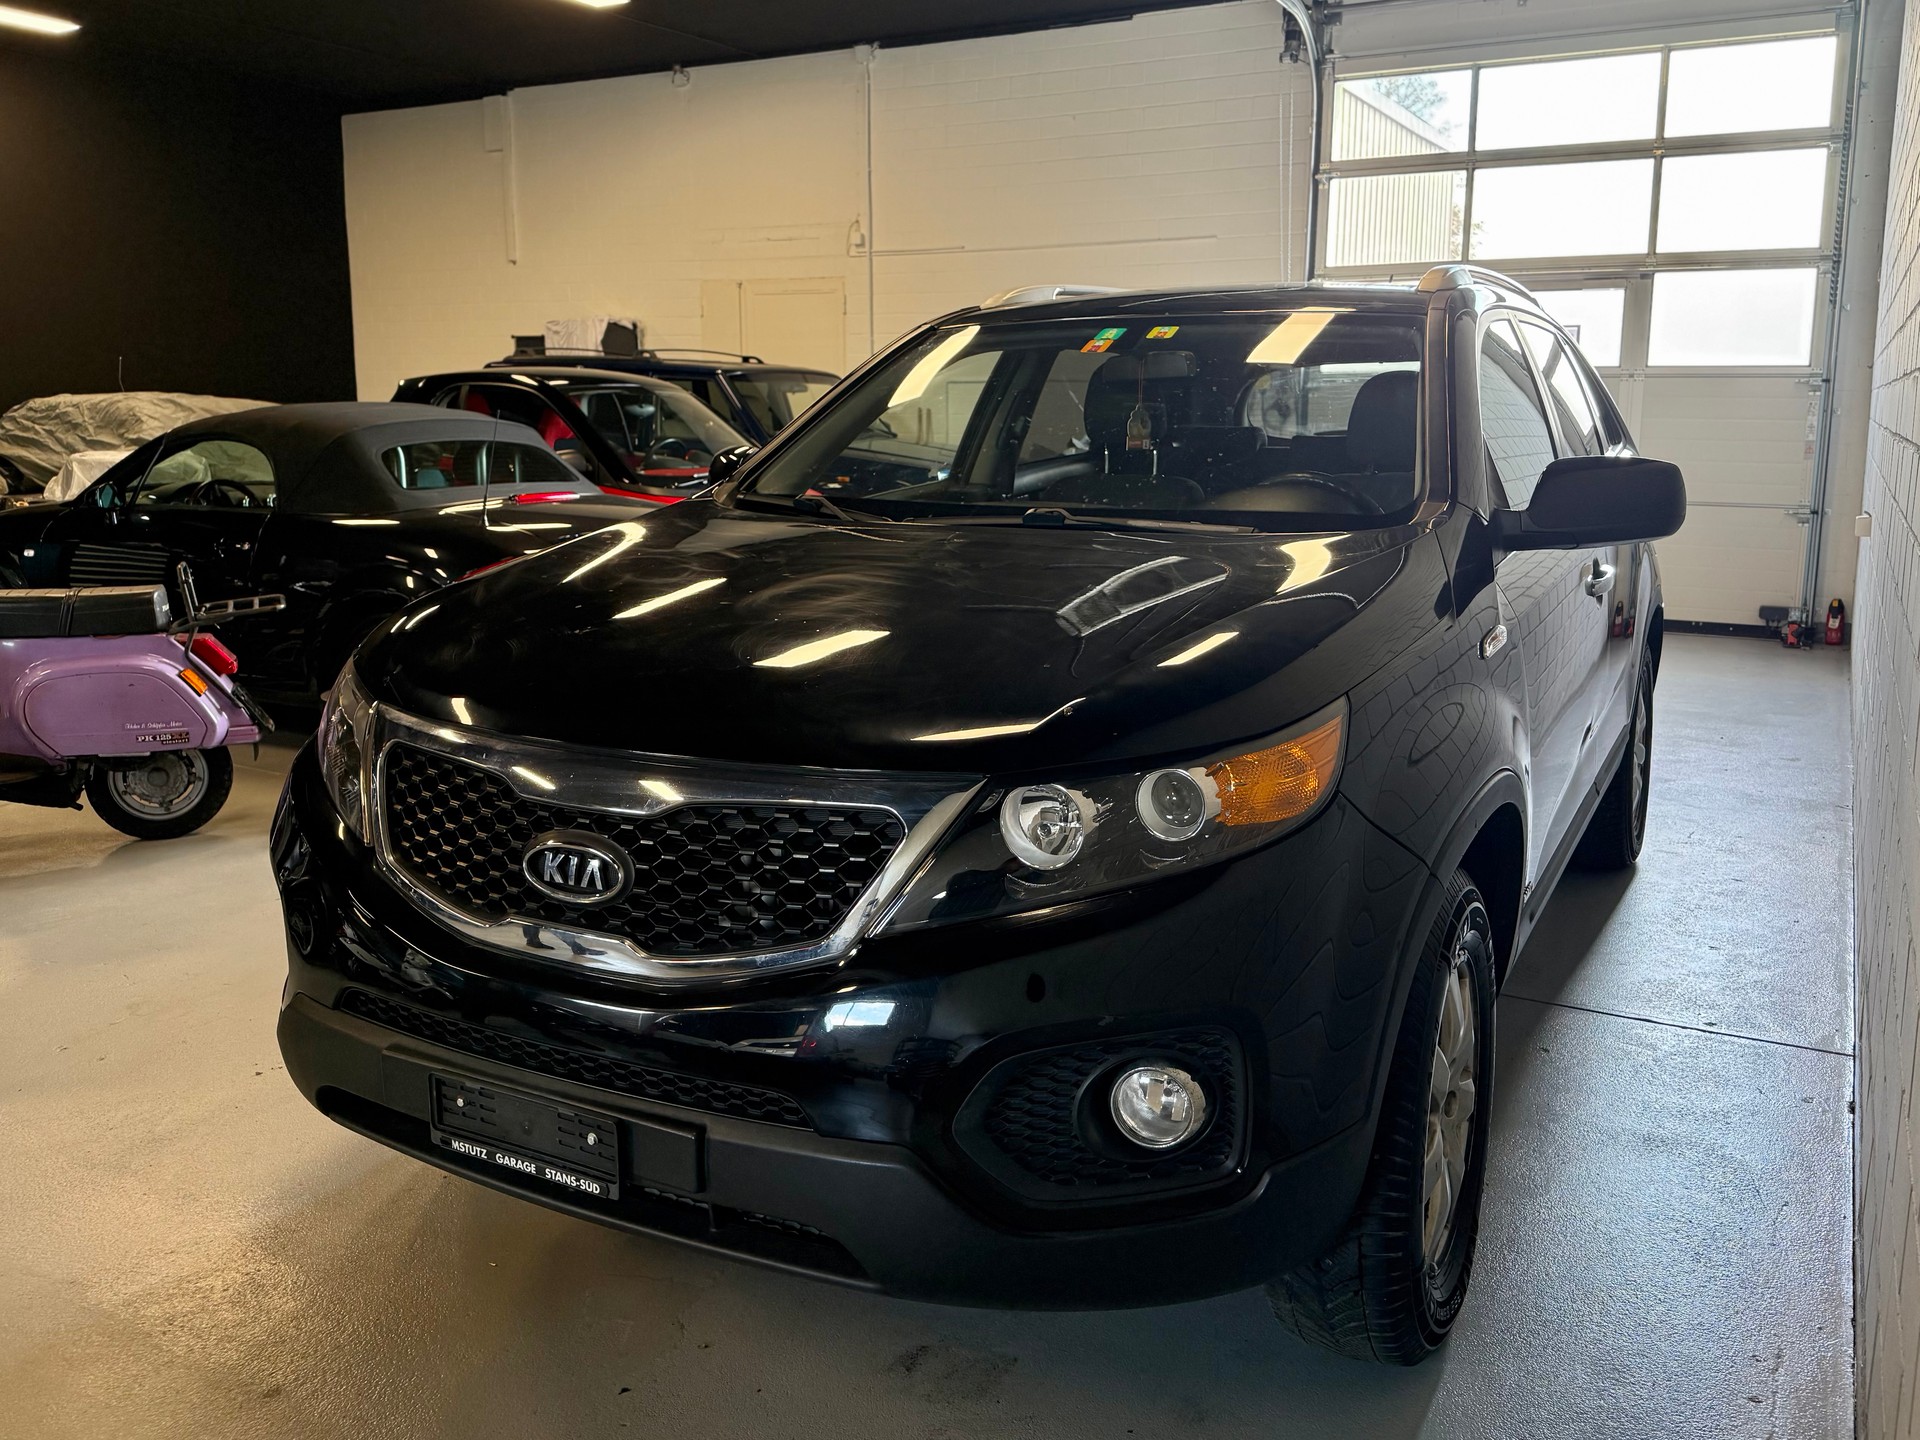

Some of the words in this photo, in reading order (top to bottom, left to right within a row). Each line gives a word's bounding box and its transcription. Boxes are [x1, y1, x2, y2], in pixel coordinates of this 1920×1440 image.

[137, 734, 154, 742] PK
[155, 732, 172, 741] 125
[543, 850, 603, 891] KIA
[495, 1153, 537, 1175] GARAGE
